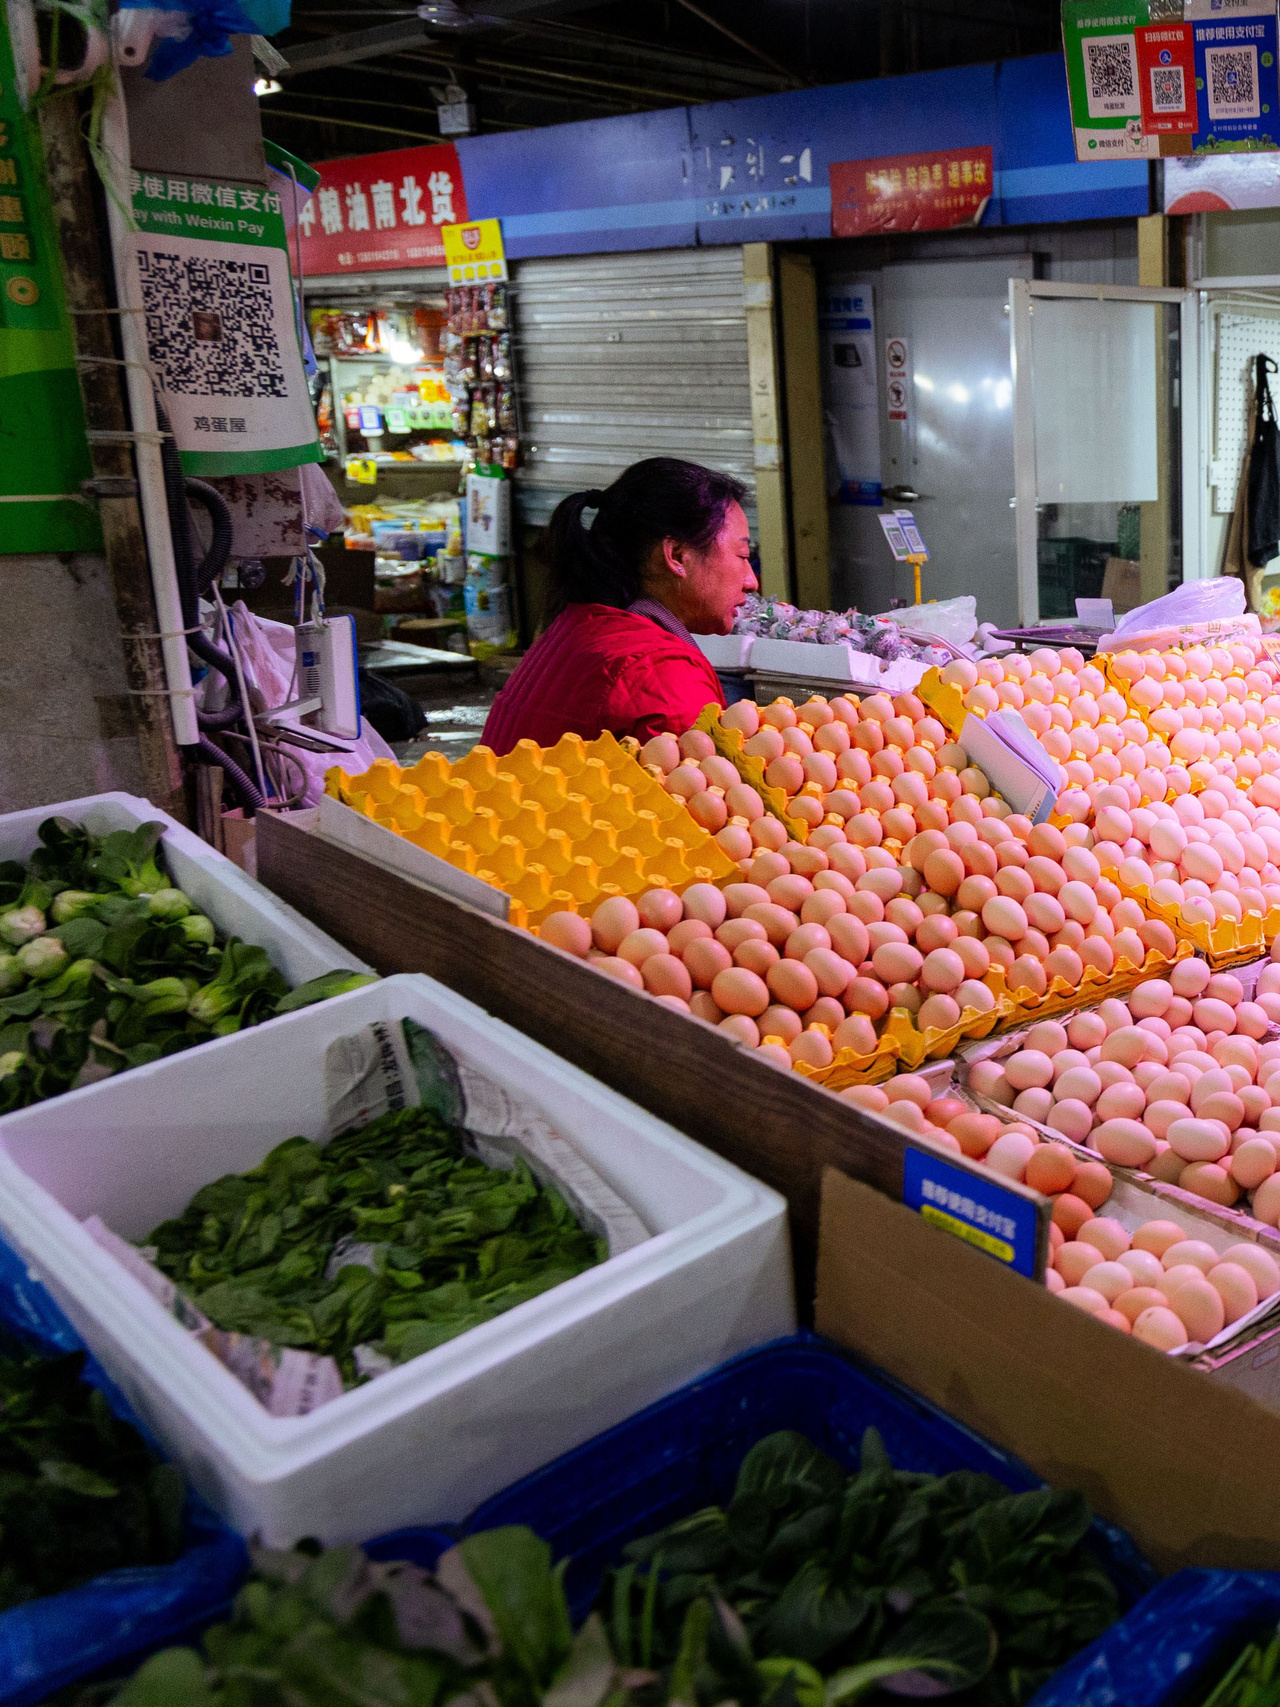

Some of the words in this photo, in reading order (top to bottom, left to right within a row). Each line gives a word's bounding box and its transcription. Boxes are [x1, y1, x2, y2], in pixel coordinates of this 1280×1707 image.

[1144, 29, 1185, 43] 扫码领红包
[1195, 24, 1266, 42] 推荐使用支付宝
[150, 209, 182, 225] with
[185, 213, 235, 232] Weixin
[237, 219, 265, 238] Pay
[193, 416, 248, 433] 鸡蛋屋
